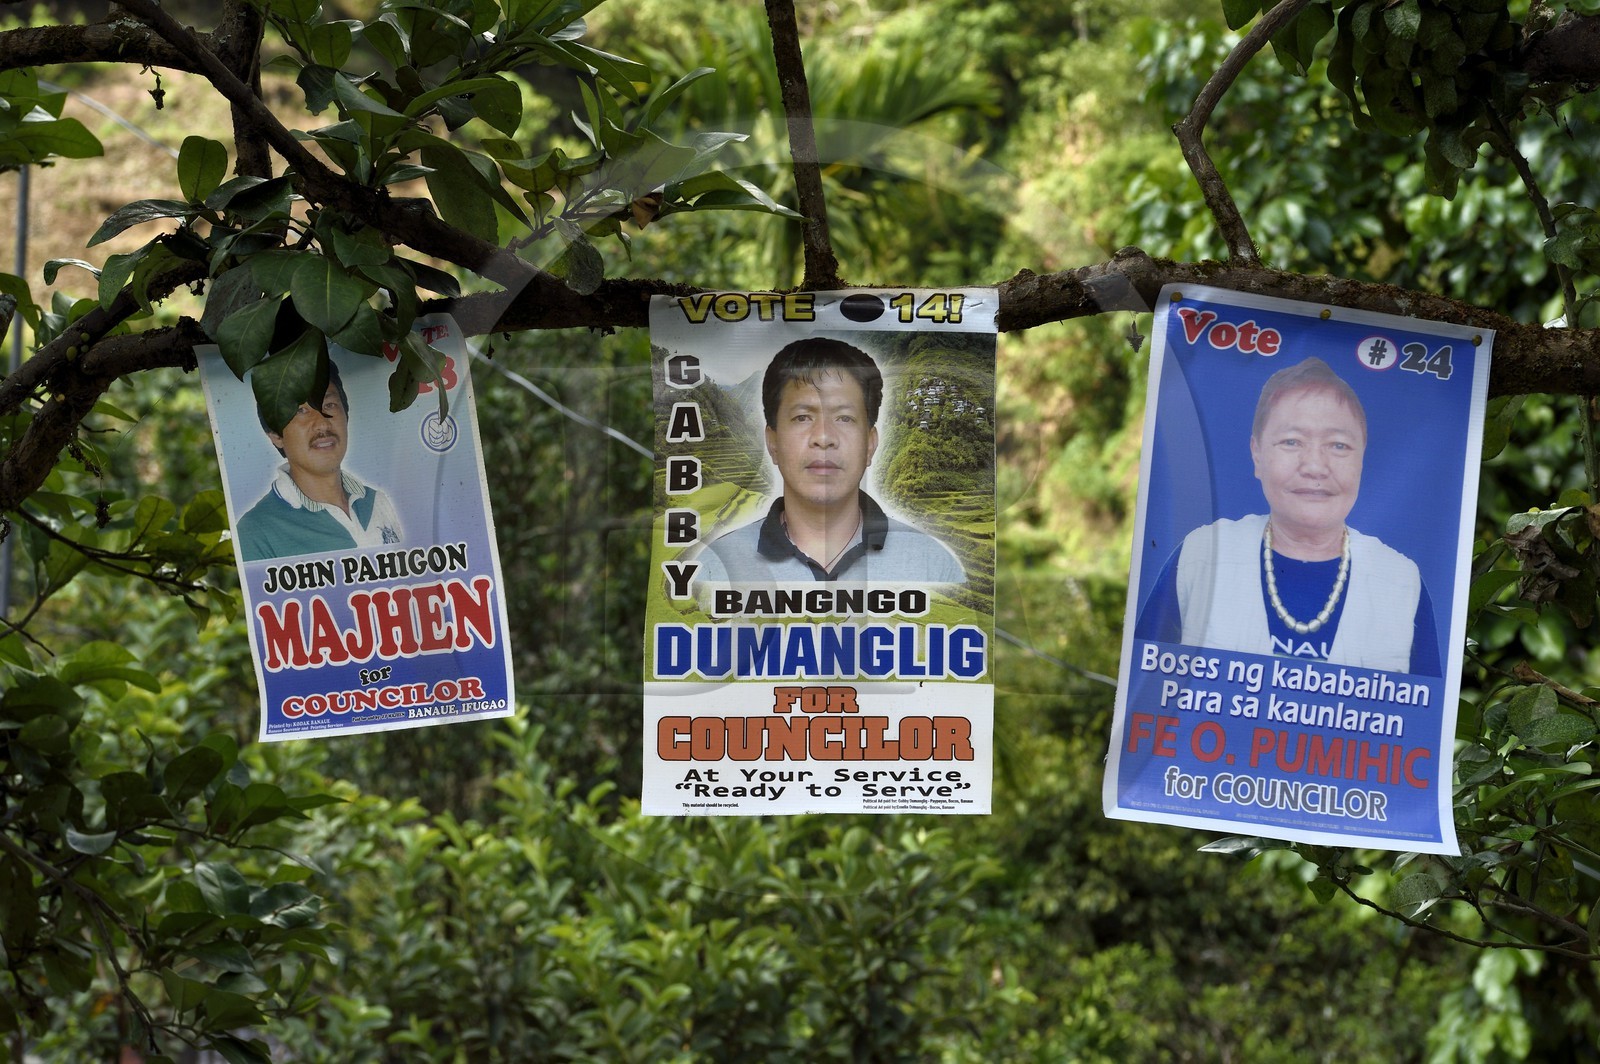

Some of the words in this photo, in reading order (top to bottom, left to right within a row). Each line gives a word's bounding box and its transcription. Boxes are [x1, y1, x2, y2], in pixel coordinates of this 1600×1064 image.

[677, 292, 817, 324] VOTE
[889, 292, 966, 325] 14!
[1177, 306, 1281, 356] Vote
[1400, 342, 1453, 380] 24
[662, 353, 705, 599] GABBY
[263, 560, 336, 594] JOHN
[343, 543, 468, 585] PAHIGON
[257, 578, 495, 670] MAJHEN
[713, 587, 930, 617] BANGNGO
[654, 623, 987, 681] DUMANGLIG
[1141, 643, 1220, 680] Boses
[1227, 658, 1264, 689] ng
[1271, 660, 1431, 707] kababaihan
[282, 678, 486, 718] COUNCILOR
[359, 666, 391, 686] for
[408, 704, 459, 719] BANAUE,
[461, 699, 506, 713] IFUGAO
[773, 686, 859, 714] FOR
[1161, 680, 1222, 714] Para
[1230, 696, 1259, 718] sa
[1267, 695, 1404, 736] kaunlaran
[657, 715, 975, 761] COUNCILOR
[1127, 713, 1180, 758] FE
[1190, 721, 1236, 765] O.
[1249, 727, 1431, 789] PUMIHIC
[684, 768, 720, 783] At
[740, 768, 814, 783] Your
[835, 767, 962, 783] Service
[810, 785, 842, 798] to
[1164, 765, 1208, 800] for
[1212, 772, 1388, 822] COUNCILOR
